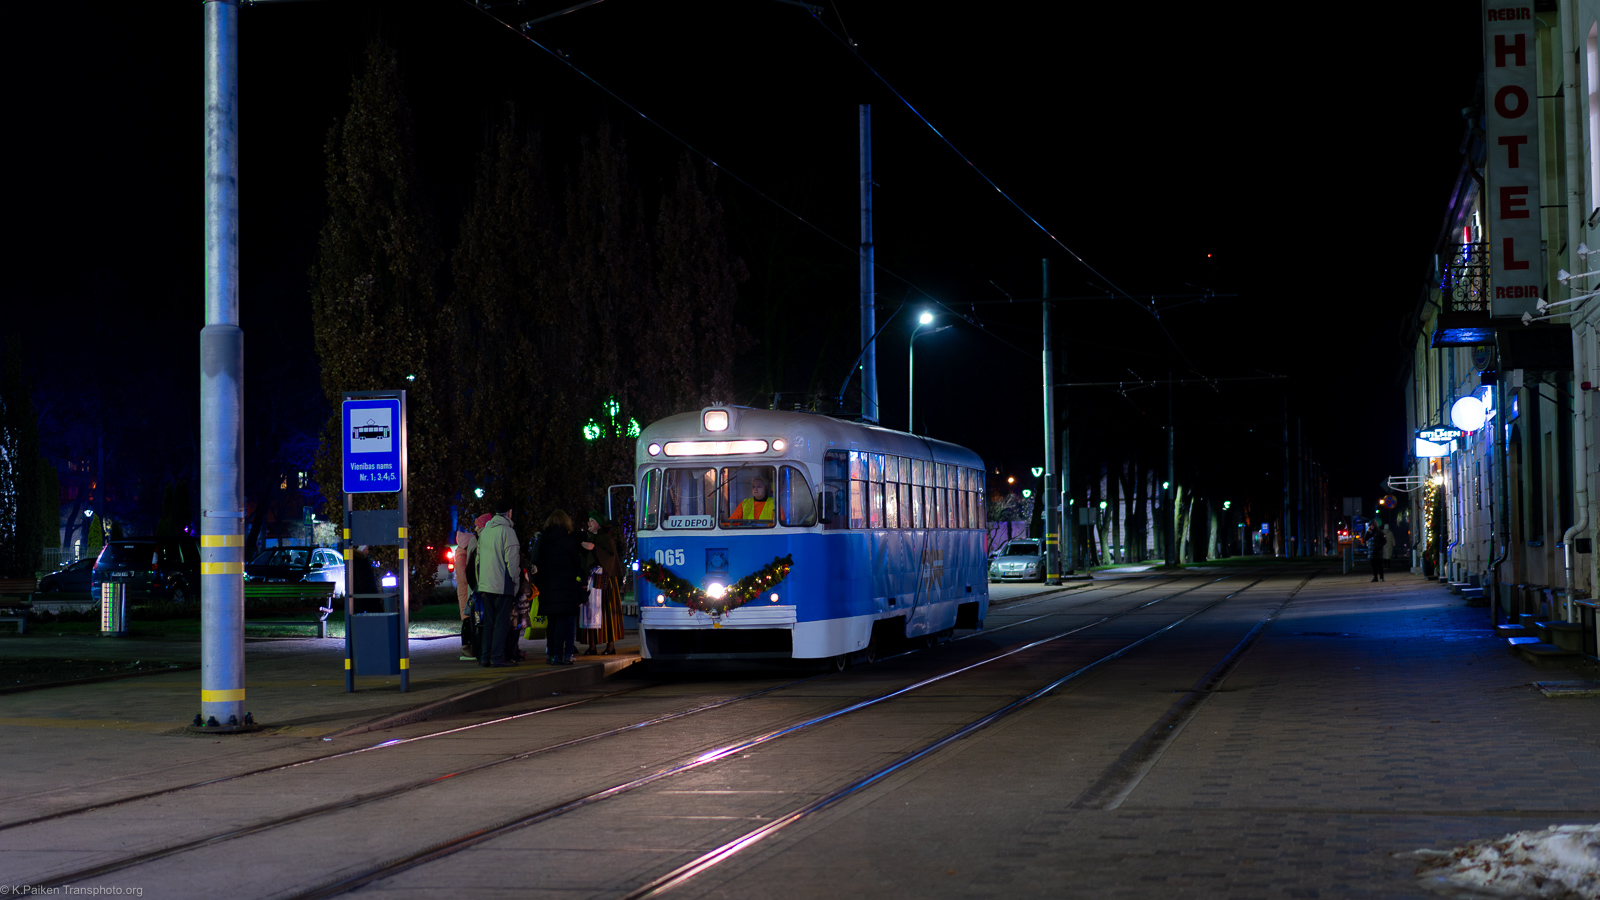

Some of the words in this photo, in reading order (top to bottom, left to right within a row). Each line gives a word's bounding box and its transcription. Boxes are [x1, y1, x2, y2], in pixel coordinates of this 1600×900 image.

[1487, 7, 1531, 22] REBIR
[1494, 33, 1530, 270] HOTEL
[1495, 285, 1539, 299] REBIR
[350, 462, 375, 470] Vienības
[359, 473, 369, 481] Nr.
[671, 519, 682, 527] UZ
[684, 518, 707, 527] DEPO
[655, 548, 685, 566] 065
